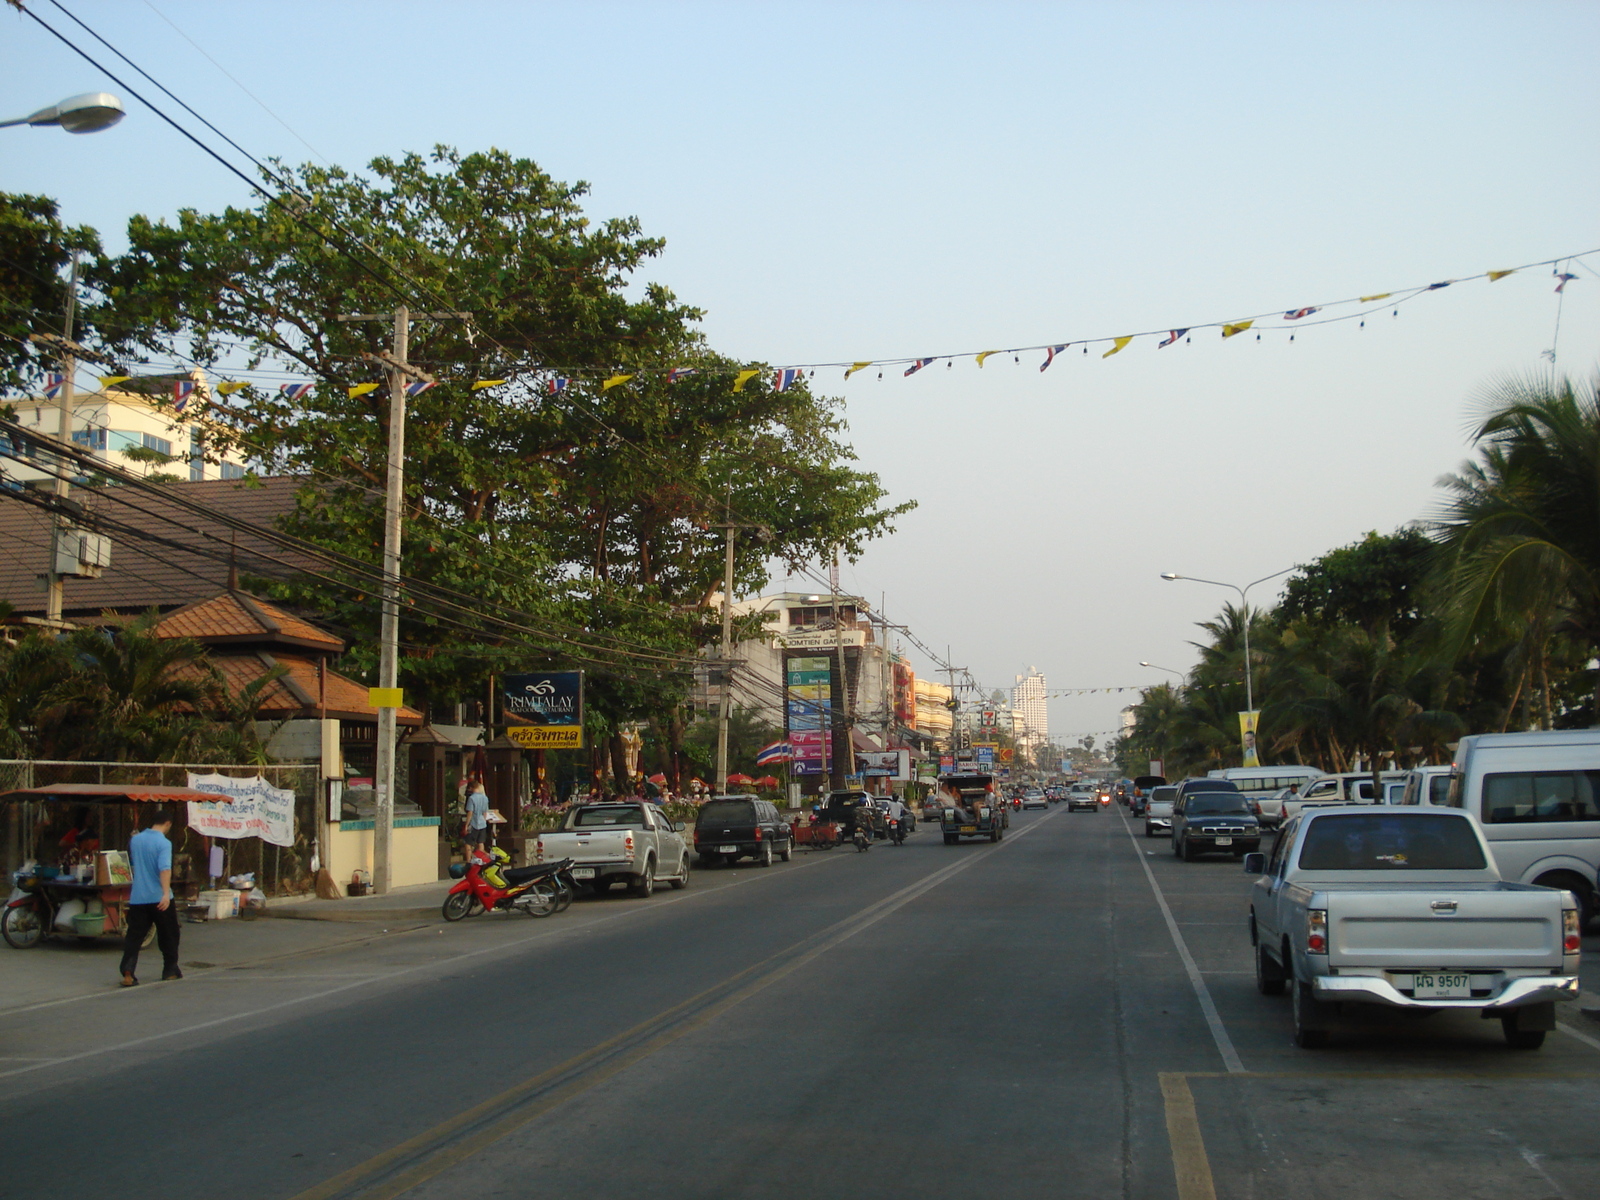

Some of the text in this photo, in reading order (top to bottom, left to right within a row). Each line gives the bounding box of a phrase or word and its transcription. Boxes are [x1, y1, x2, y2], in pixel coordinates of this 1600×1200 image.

[823, 637, 854, 645] GAREN
[510, 696, 574, 708] RIMTALAY
[1439, 976, 1468, 987] 9507
